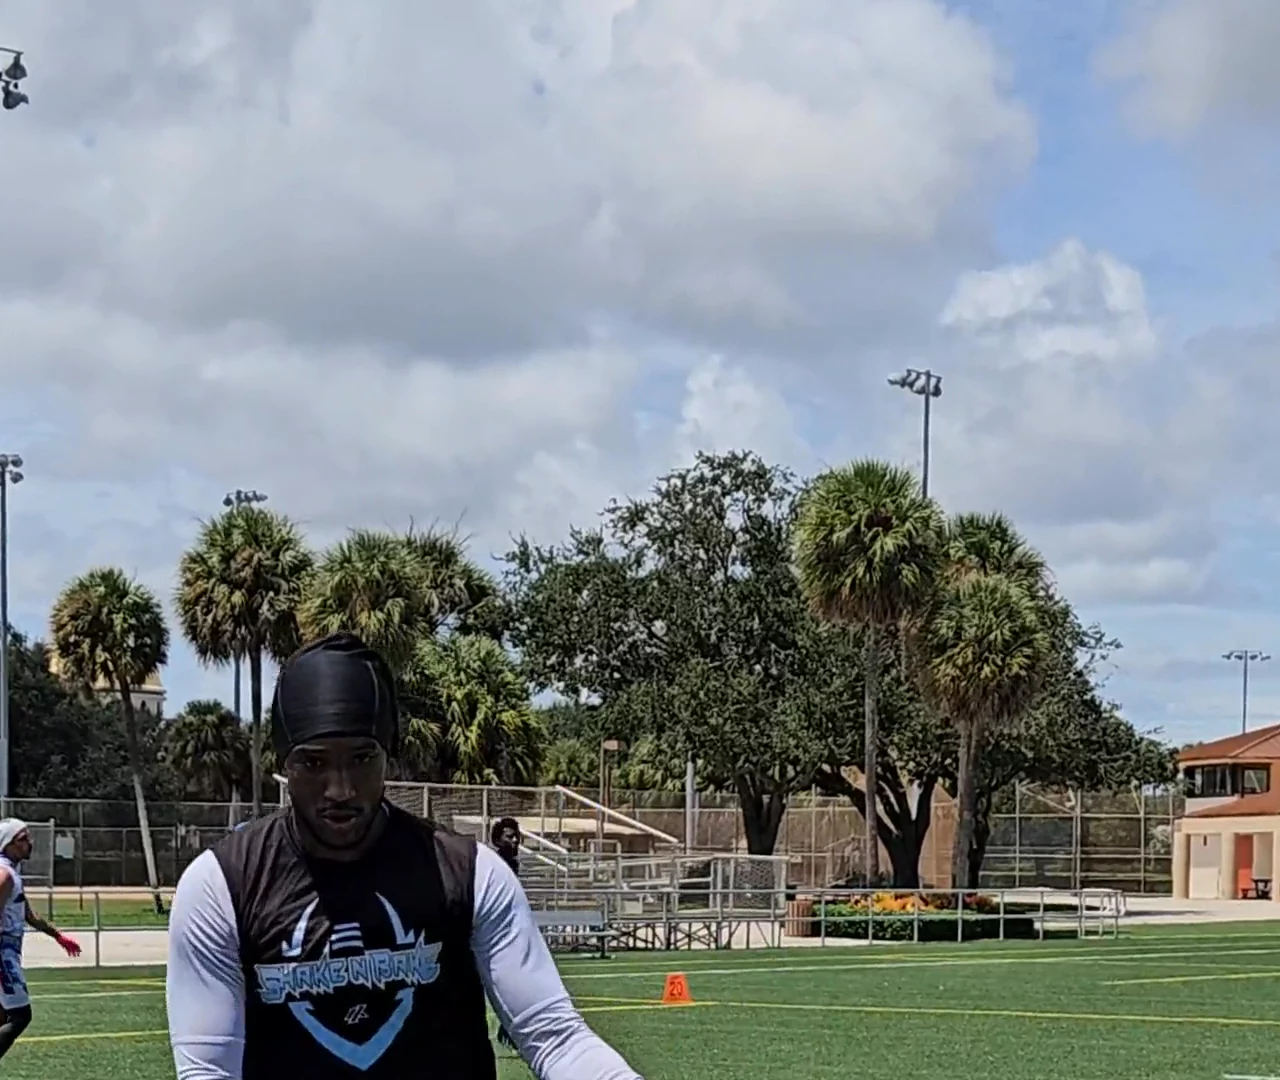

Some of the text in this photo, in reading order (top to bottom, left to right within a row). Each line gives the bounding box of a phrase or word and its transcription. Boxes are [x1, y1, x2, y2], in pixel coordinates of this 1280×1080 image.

[254, 944, 348, 1004] SHAKE
[369, 936, 443, 990] BAKE
[669, 981, 683, 997] 20
